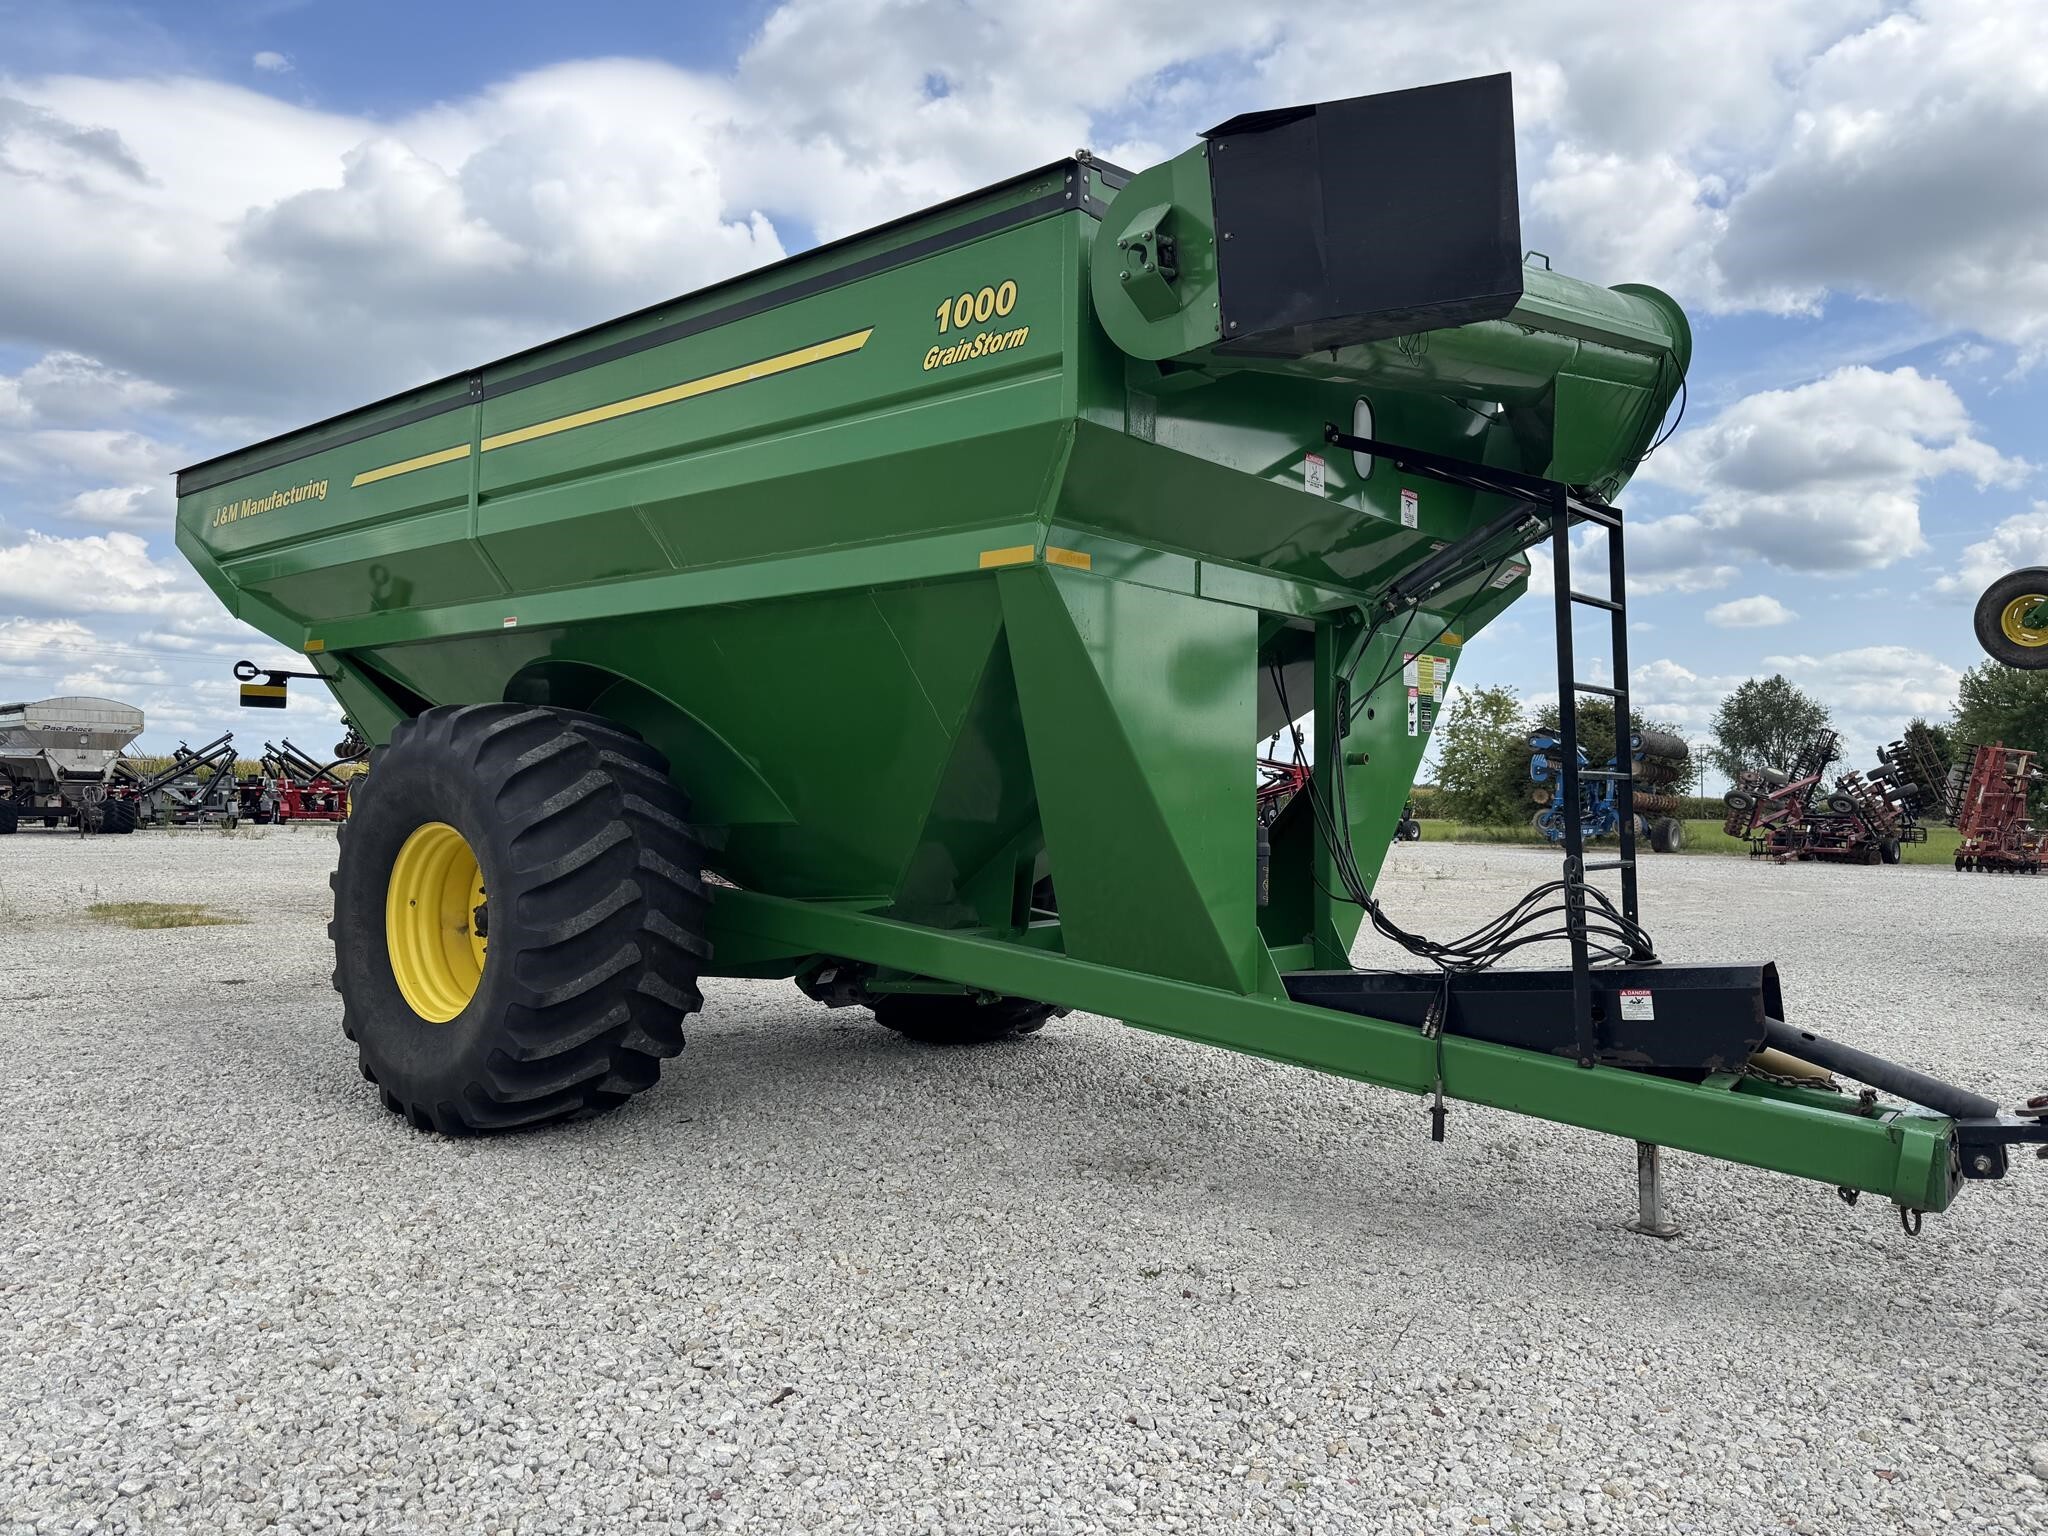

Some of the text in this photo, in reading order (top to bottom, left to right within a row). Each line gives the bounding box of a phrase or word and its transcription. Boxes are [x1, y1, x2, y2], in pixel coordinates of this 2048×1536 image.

[935, 279, 1018, 335] 1000
[922, 325, 1030, 372] GrainStorm
[212, 479, 329, 528] J&M Manufacturing
